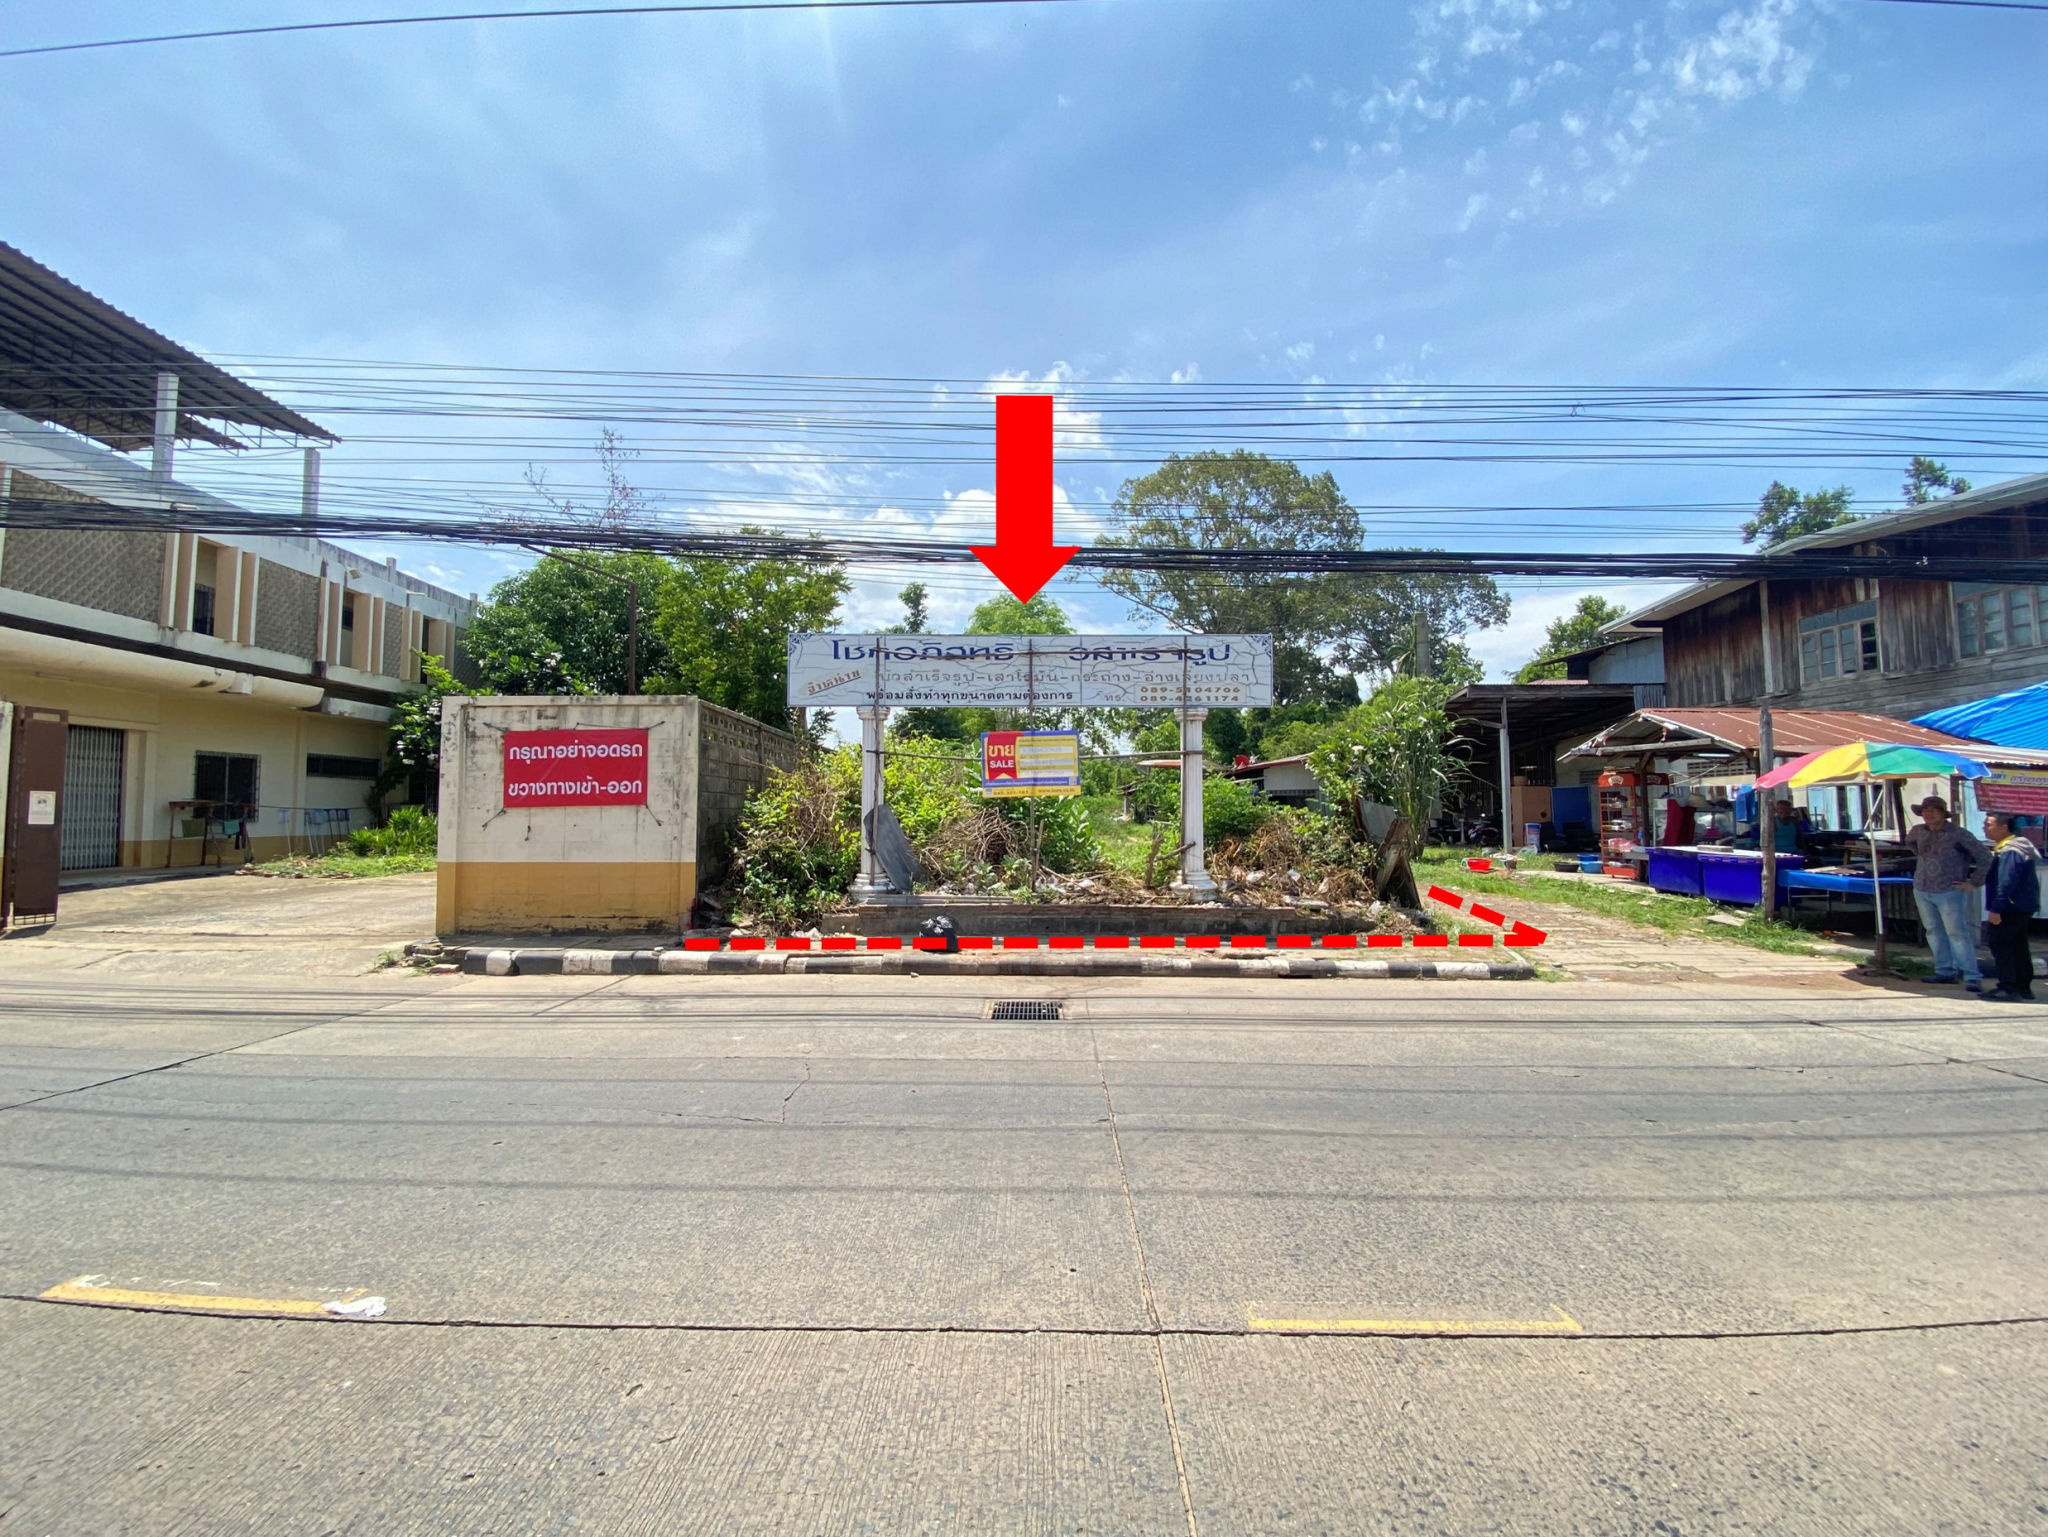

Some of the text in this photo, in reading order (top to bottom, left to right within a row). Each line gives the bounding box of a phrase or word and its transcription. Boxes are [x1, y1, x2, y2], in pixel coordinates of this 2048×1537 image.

[866, 685, 1073, 704] พร้อมสั่งทำทุกขนาดตามต้องการ
[509, 739, 643, 764] กรุณาอย่าจอดรถ
[988, 744, 1014, 757] ขาย
[989, 760, 1014, 768] SALE
[508, 775, 642, 796] ขวางทางเข้า-ออก
